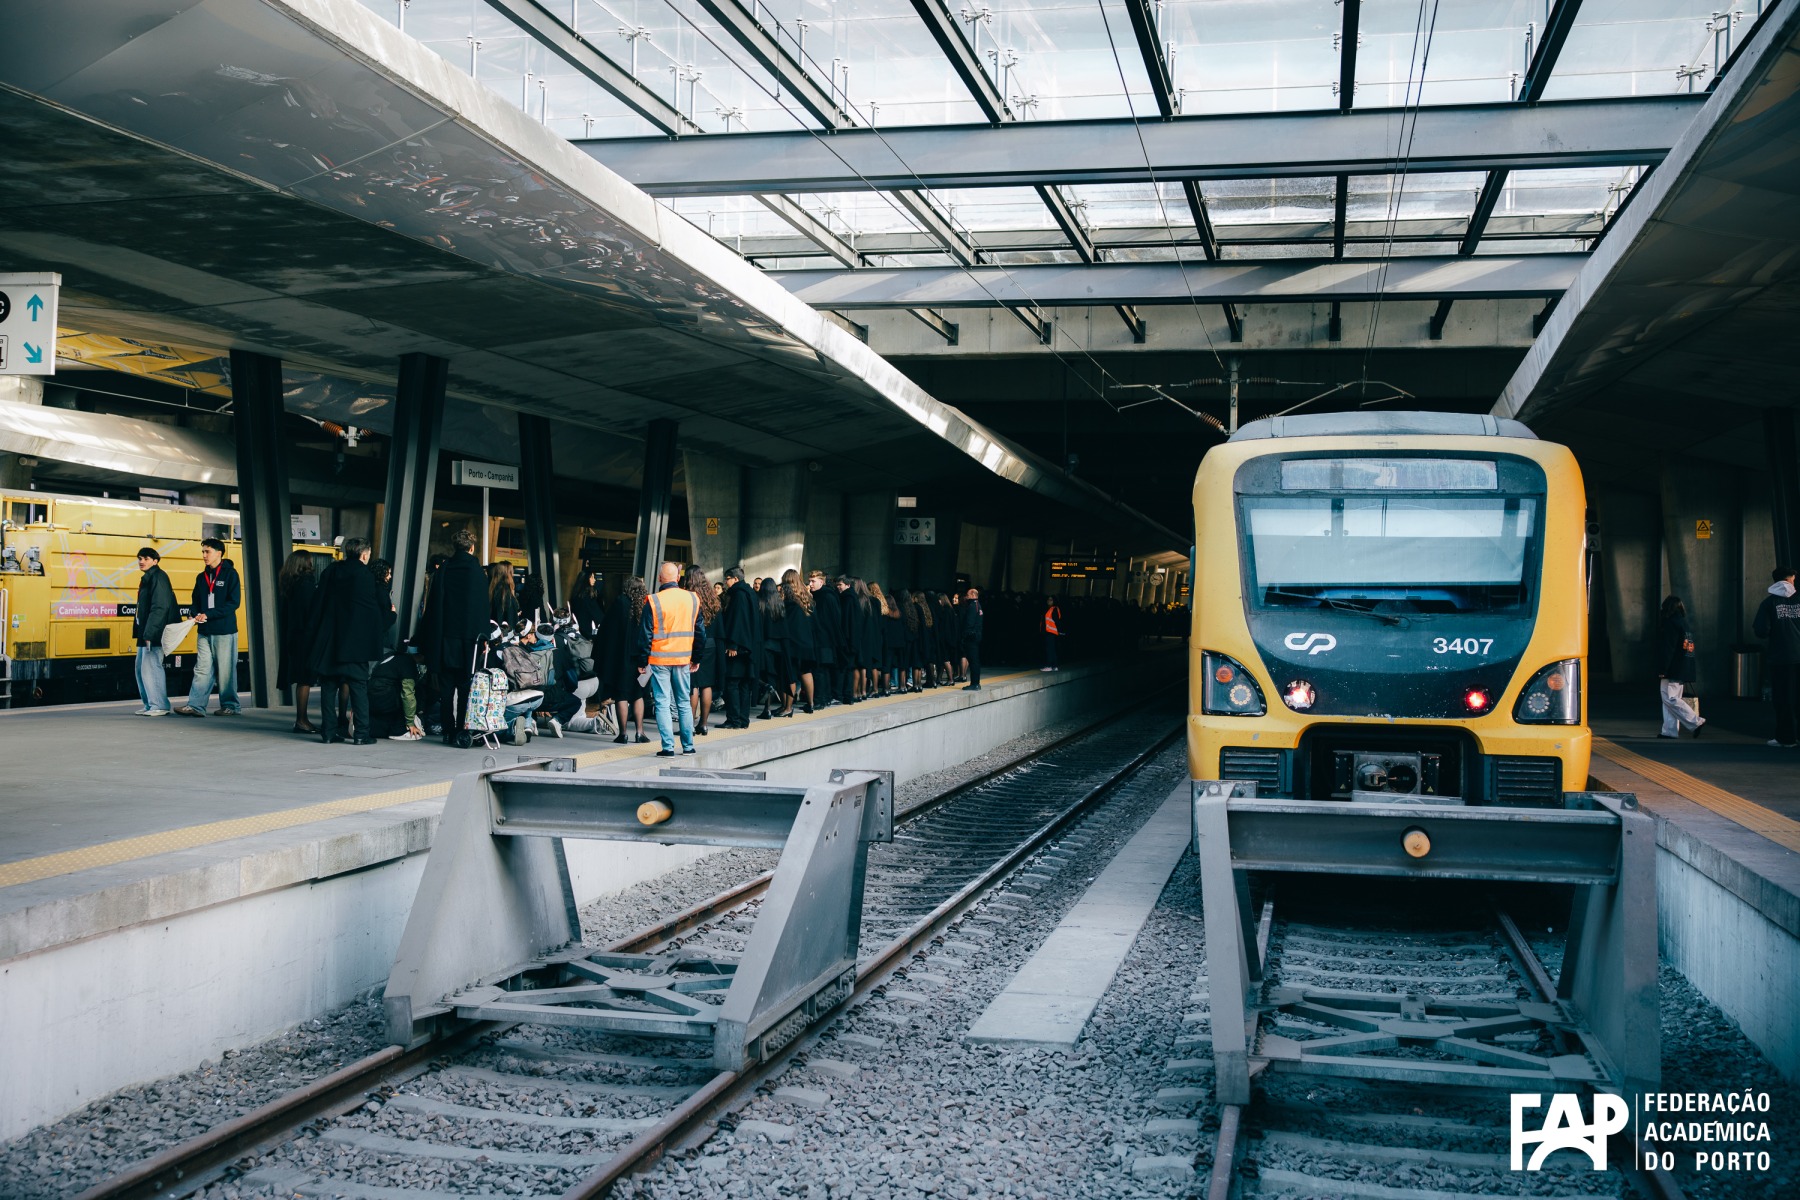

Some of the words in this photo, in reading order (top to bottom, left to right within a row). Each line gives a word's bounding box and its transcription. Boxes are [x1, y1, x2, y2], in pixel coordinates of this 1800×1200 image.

[1231, 397, 1236, 407] 2
[469, 469, 484, 478] Porto
[487, 470, 514, 482] Campanhã
[58, 606, 90, 615] Caminho
[90, 606, 98, 615] de
[100, 606, 118, 615] Ferro
[1284, 632, 1337, 656] CP
[1433, 637, 1494, 655] 3407
